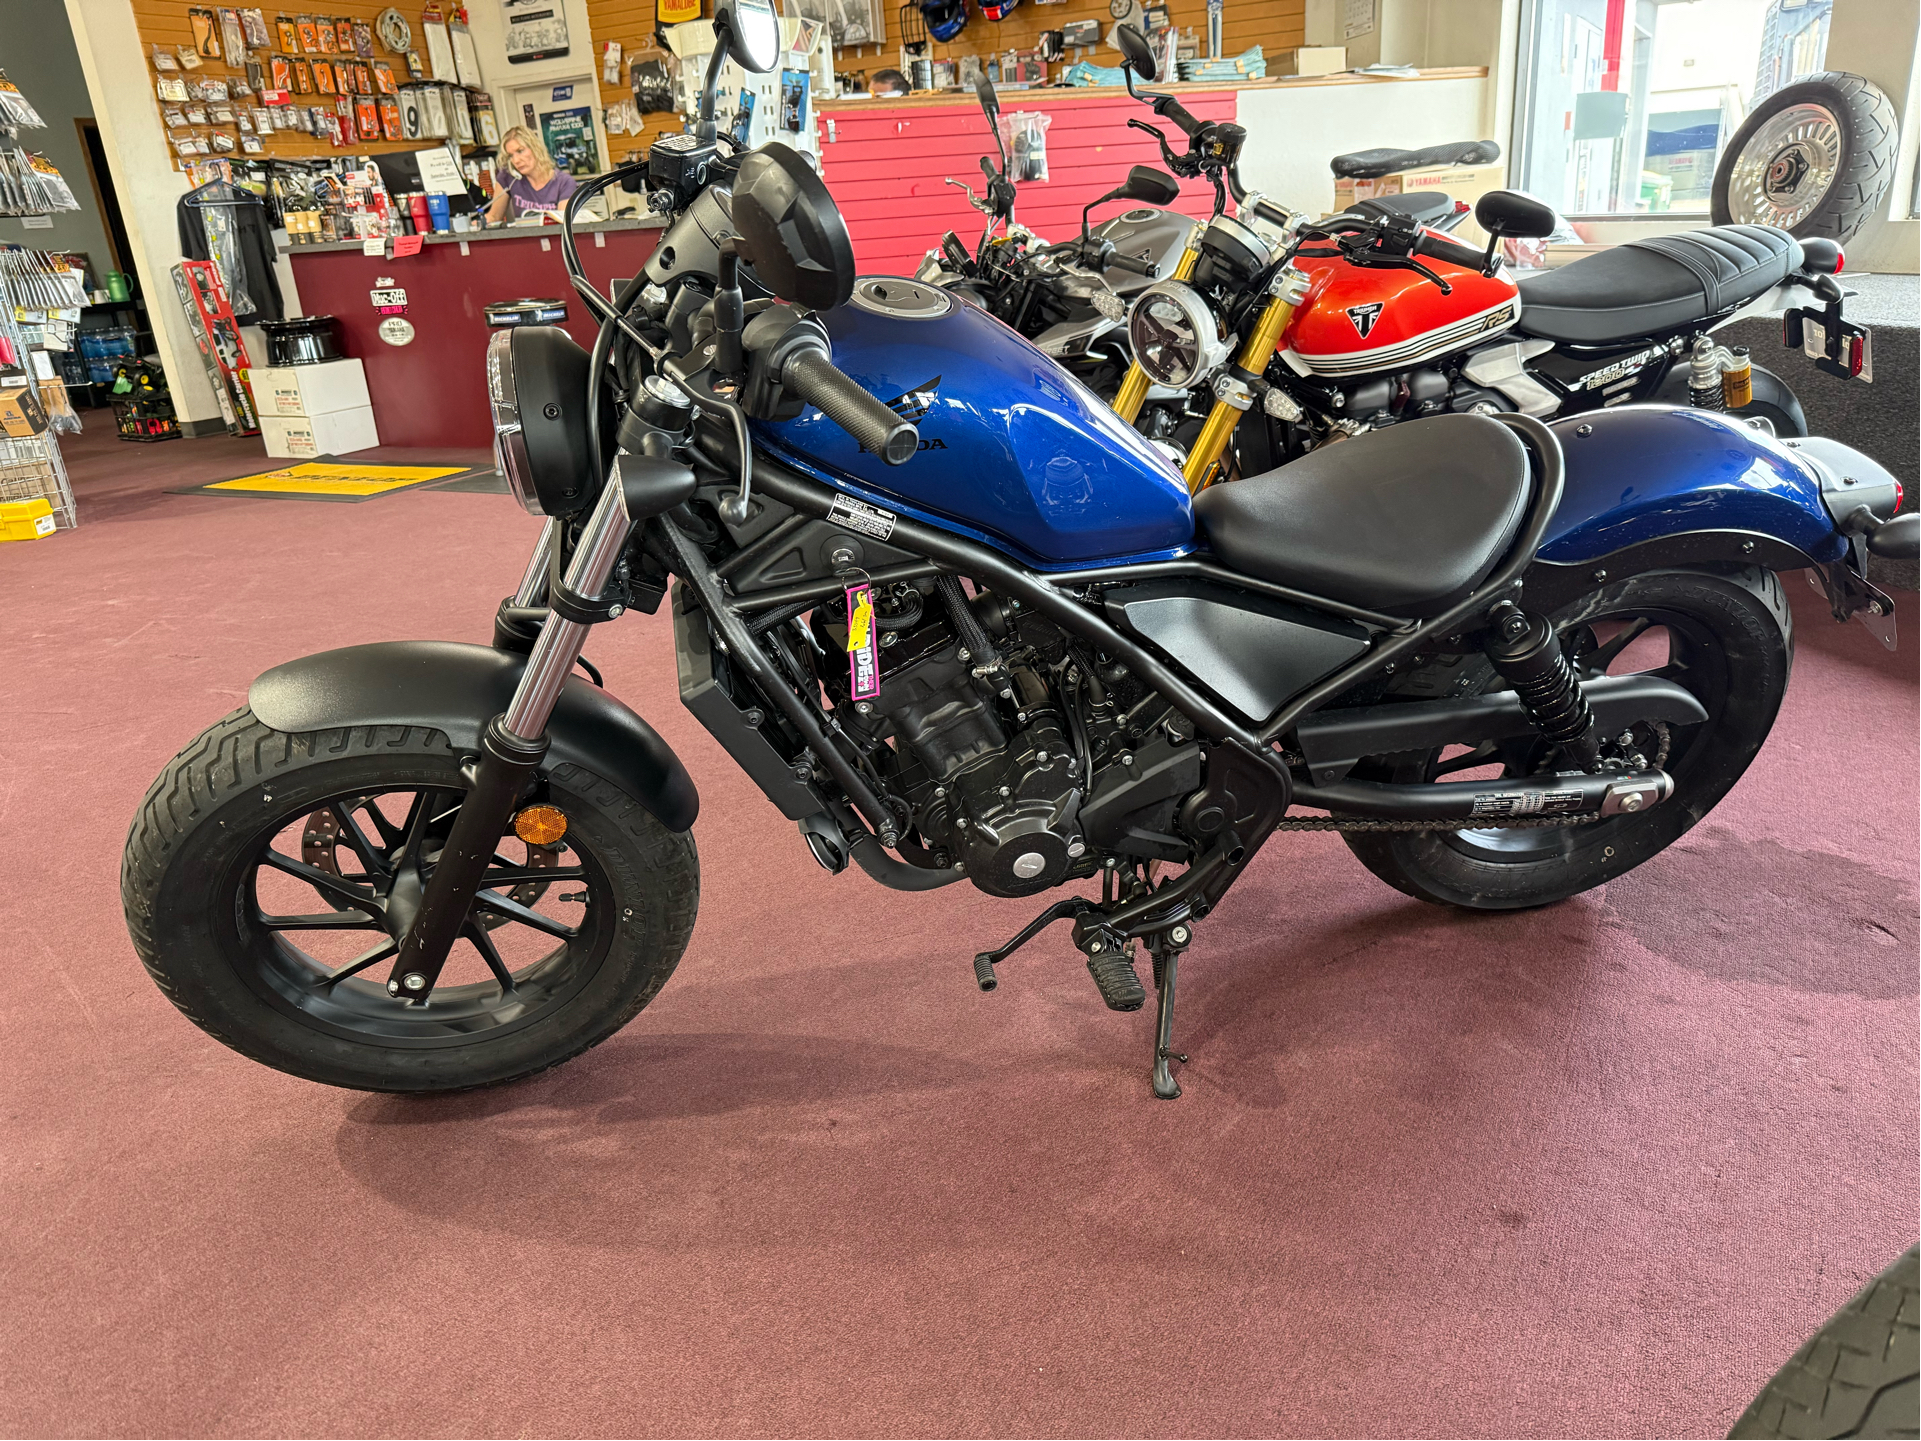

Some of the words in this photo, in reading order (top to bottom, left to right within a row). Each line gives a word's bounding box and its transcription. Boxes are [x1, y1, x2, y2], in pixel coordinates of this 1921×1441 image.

[407, 106, 419, 139] 9
[481, 114, 498, 145] 6
[1415, 177, 1442, 187] YAMAHA
[514, 194, 557, 211] TRIUMPH
[1353, 305, 1377, 314] TRIUMPH
[1480, 305, 1513, 331] RS
[1579, 363, 1620, 384] SPEED
[1586, 368, 1626, 391] 1200
[858, 438, 948, 454] HDA
